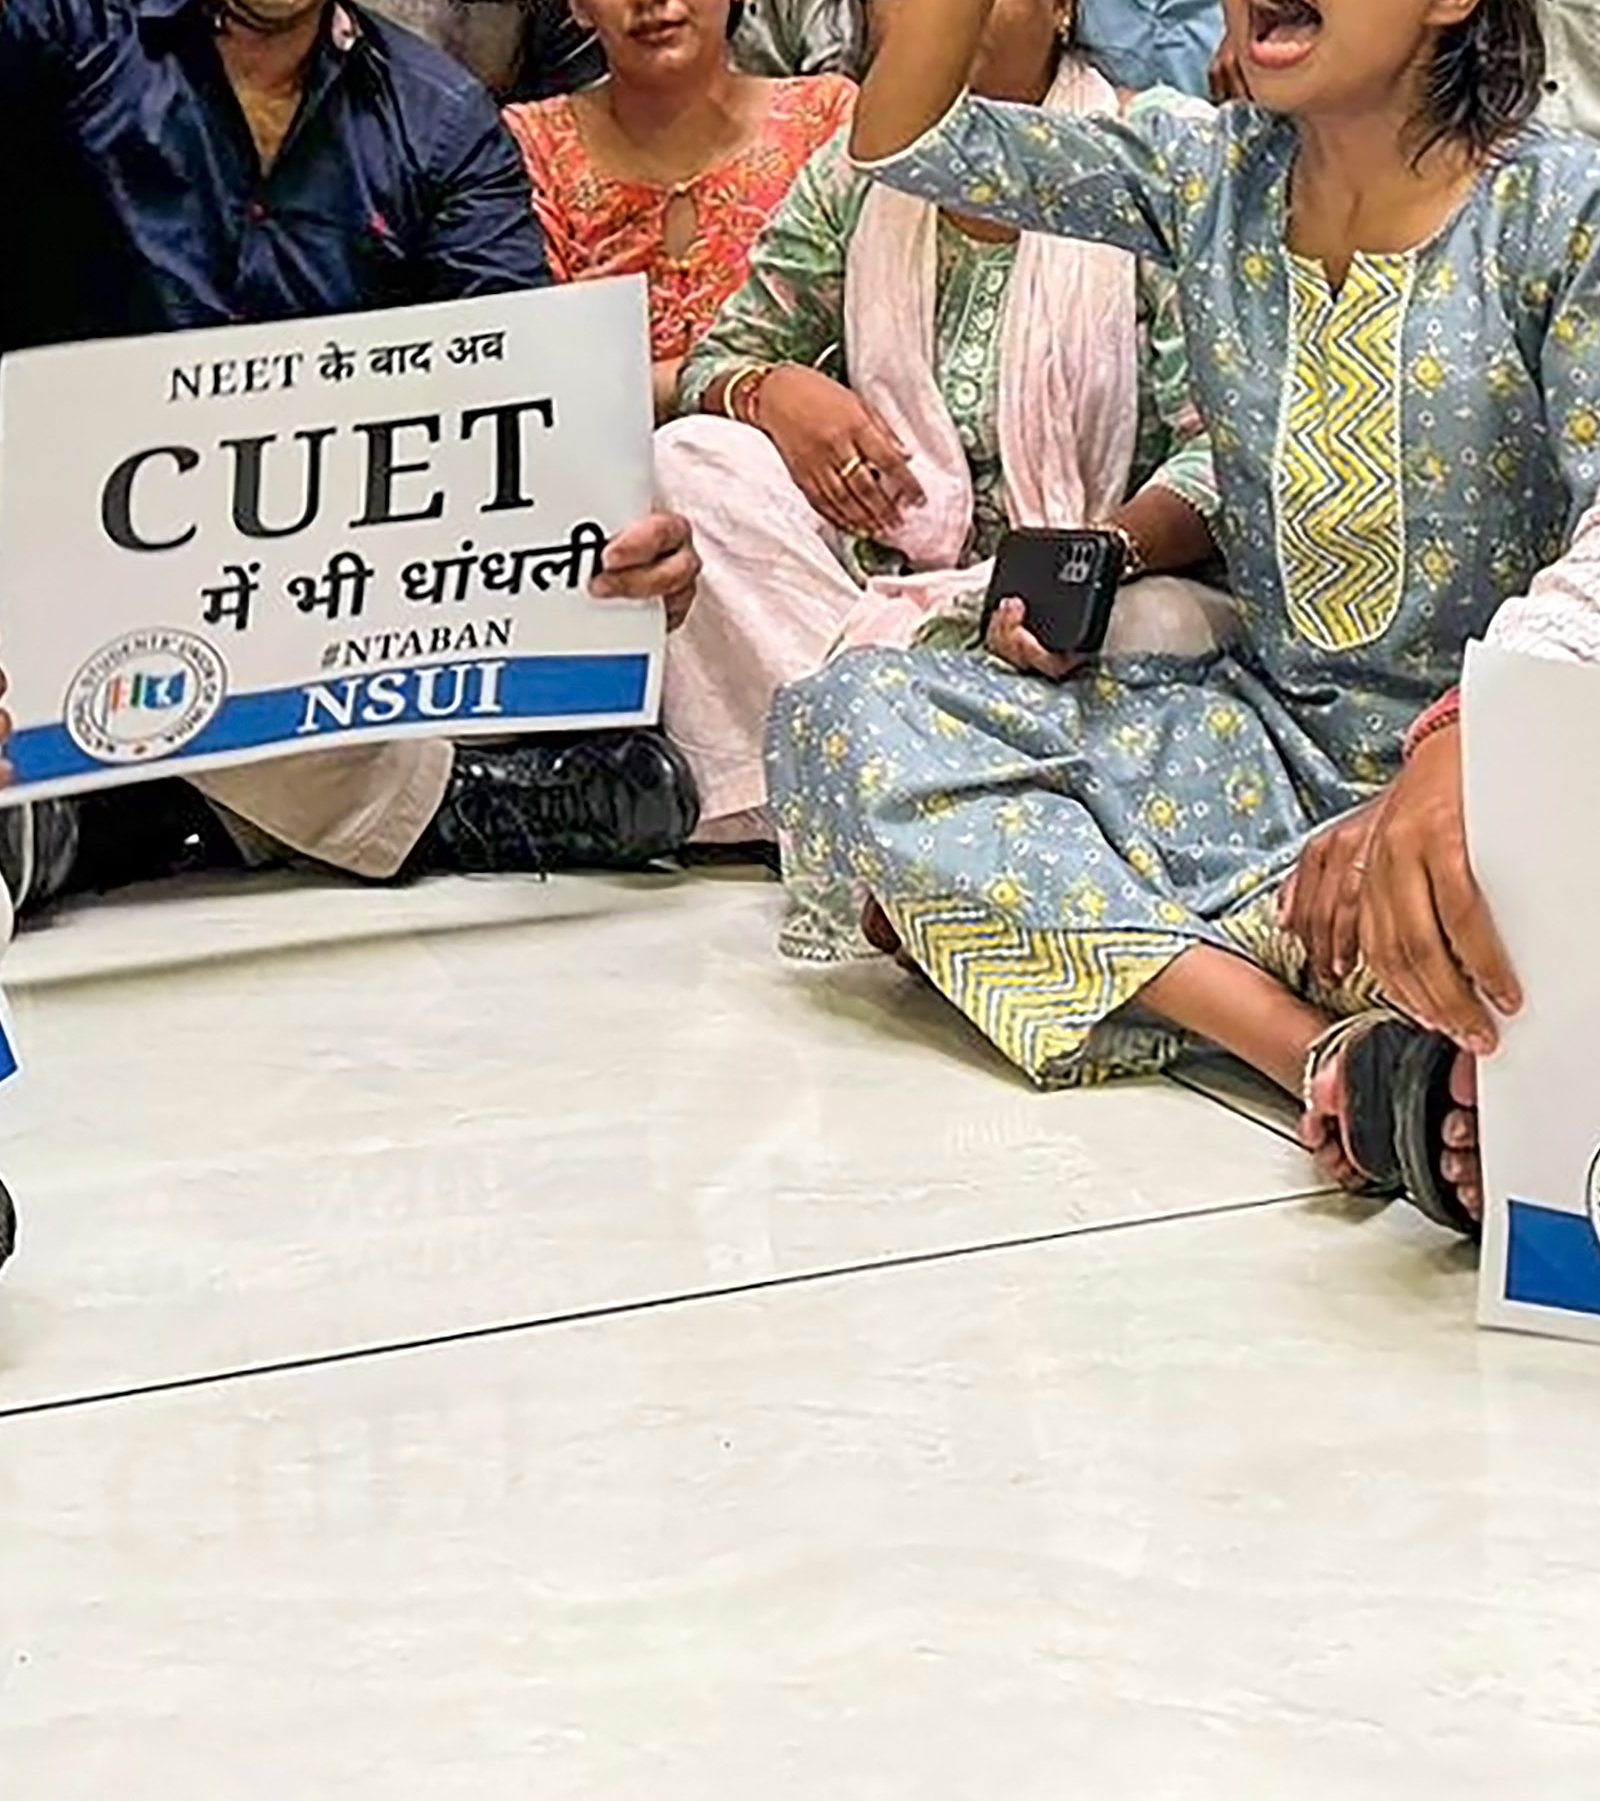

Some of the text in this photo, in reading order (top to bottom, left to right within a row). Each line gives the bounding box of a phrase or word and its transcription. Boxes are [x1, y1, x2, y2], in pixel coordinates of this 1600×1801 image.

[169, 353, 303, 400] NEET
[319, 341, 355, 381] के
[100, 398, 554, 552] CUET
[202, 522, 605, 630] में भी धांधली
[321, 618, 513, 669] #NTABAN
[297, 661, 506, 734] NSUI
